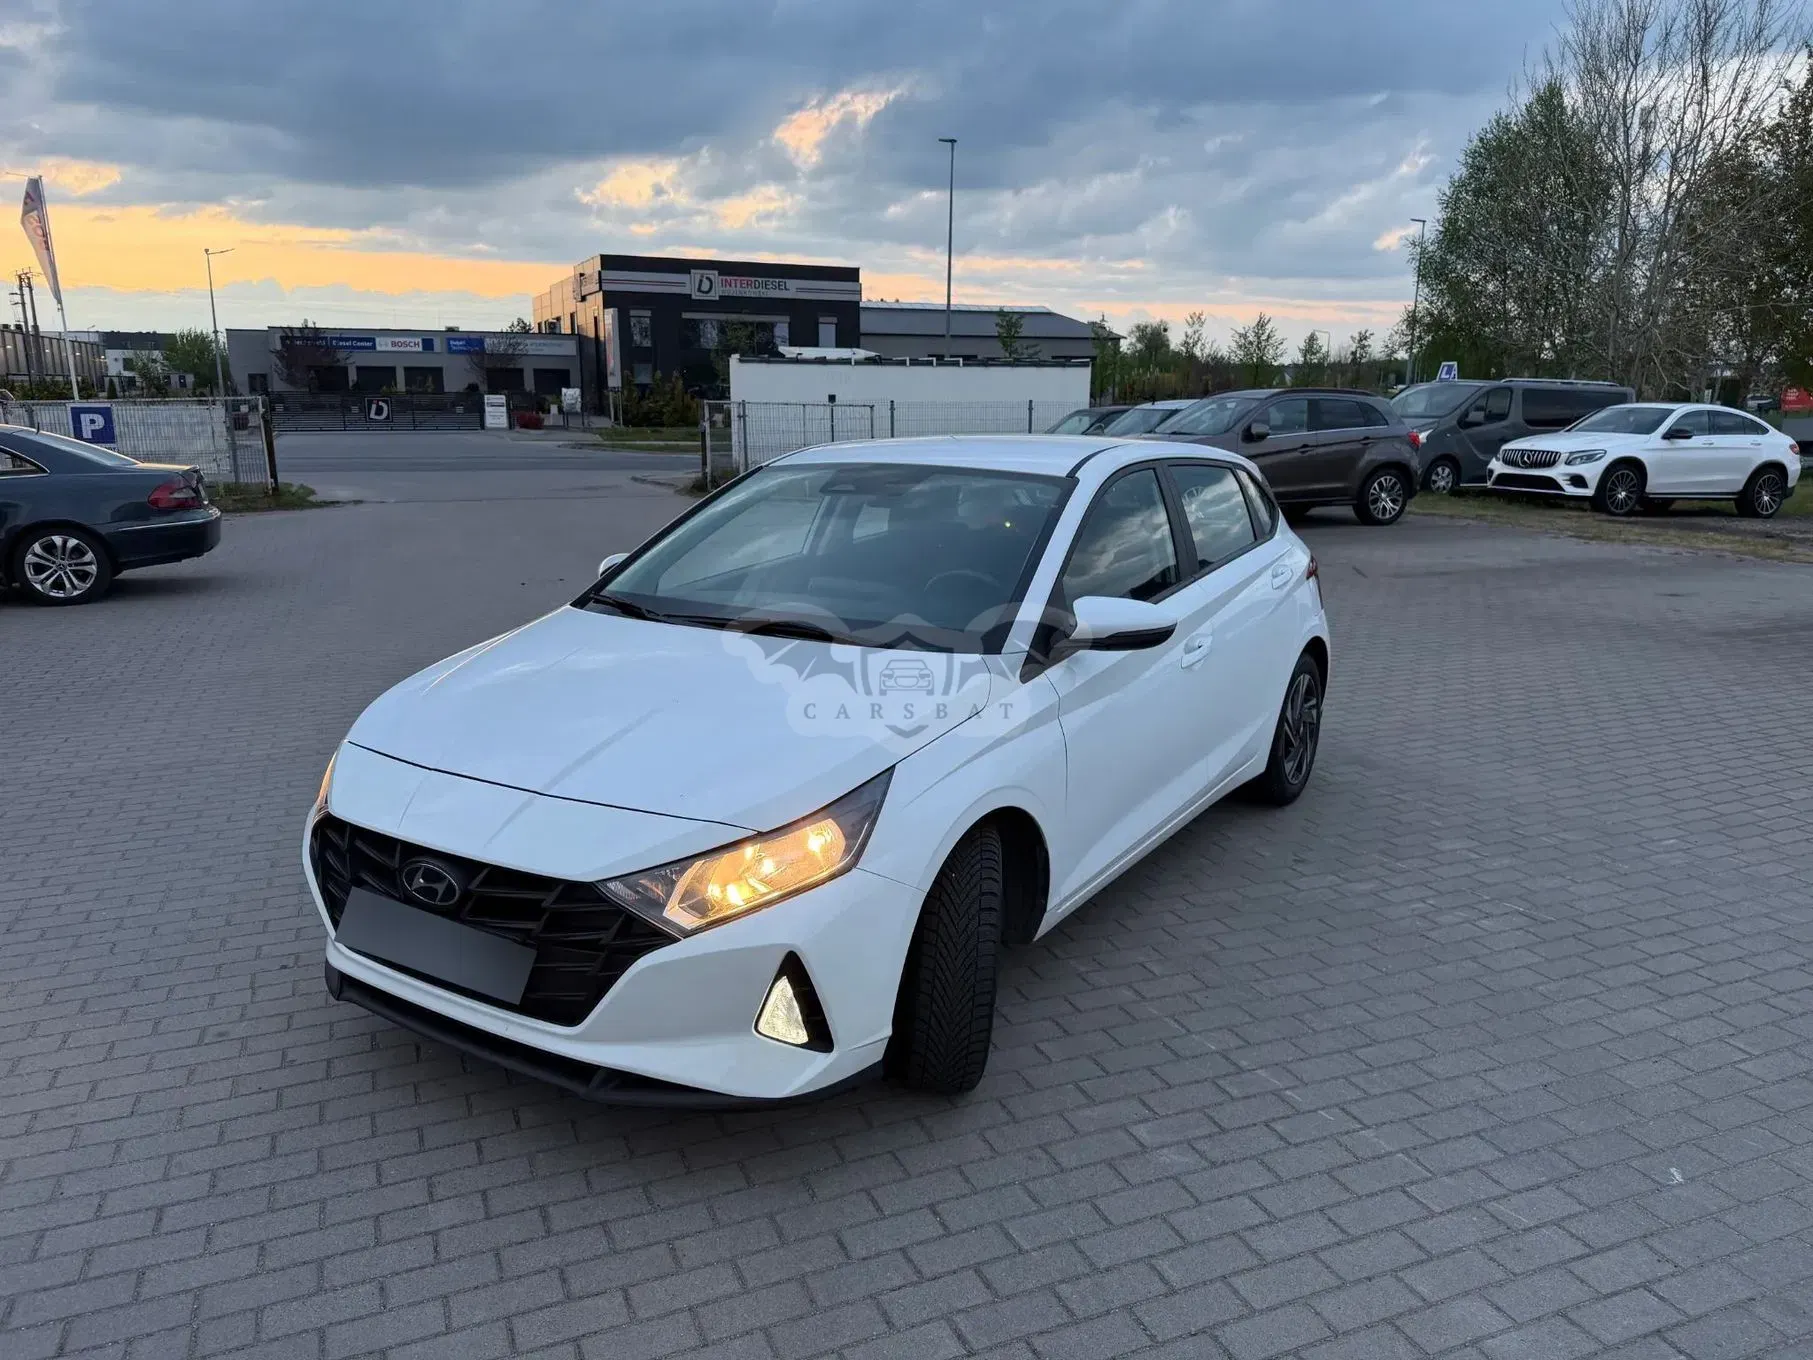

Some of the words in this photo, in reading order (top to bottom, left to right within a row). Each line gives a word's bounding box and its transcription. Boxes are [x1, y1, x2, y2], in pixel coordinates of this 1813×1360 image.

[720, 277, 790, 292] INTERDIESEL
[391, 340, 420, 349] BOSCH
[80, 413, 105, 439] P
